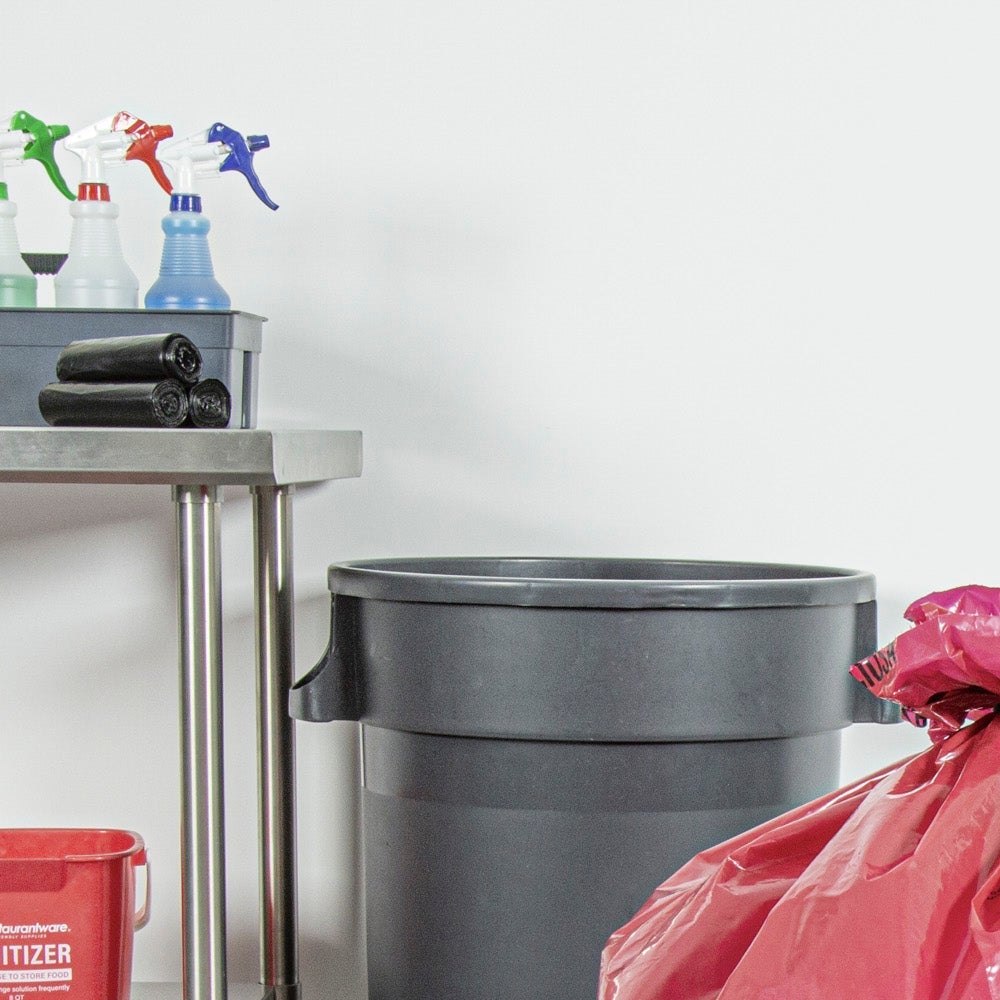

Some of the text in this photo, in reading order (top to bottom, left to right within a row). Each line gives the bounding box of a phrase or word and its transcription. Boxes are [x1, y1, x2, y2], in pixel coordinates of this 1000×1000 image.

[2, 943, 71, 965] ITIZER
[20, 972, 46, 980] STORE
[47, 971, 69, 979] FOOD
[38, 984, 70, 993] frequently
